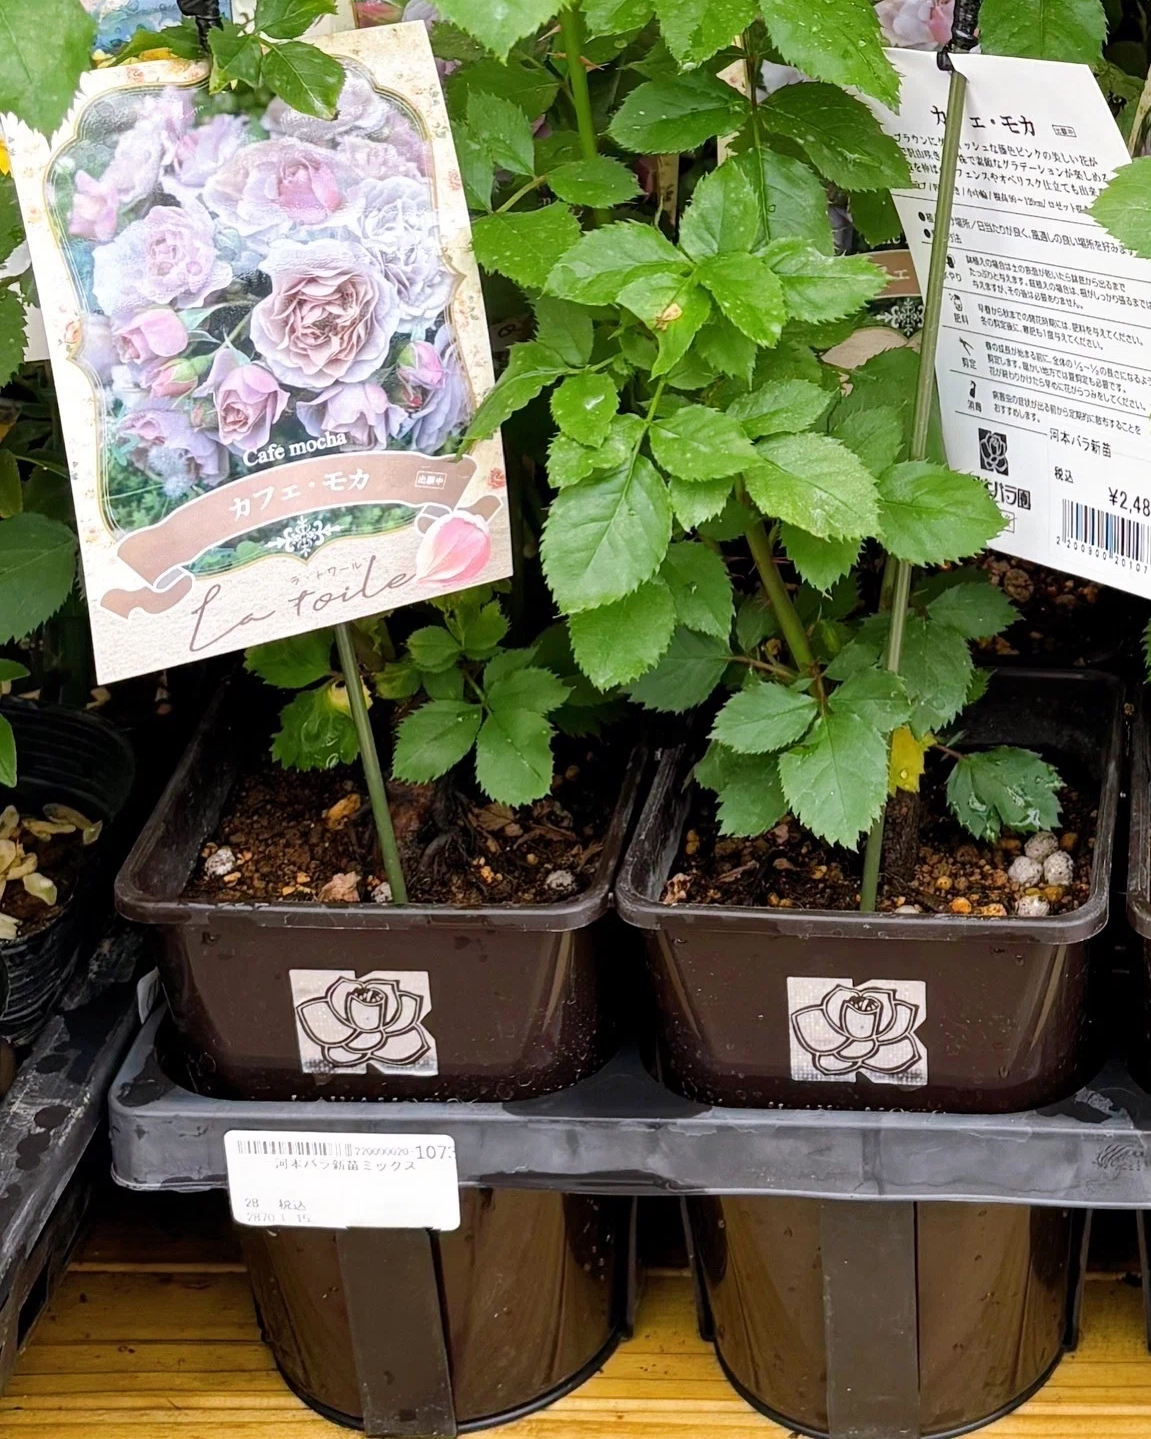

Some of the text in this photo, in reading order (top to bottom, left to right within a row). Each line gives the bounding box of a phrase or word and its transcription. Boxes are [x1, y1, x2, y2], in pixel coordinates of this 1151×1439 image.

[930, 105, 1036, 137] カェ・モカ
[243, 430, 347, 468] Café mocha
[1049, 428, 1112, 458] 河本バラ新苗
[1054, 466, 1074, 484] 税込
[227, 467, 371, 521] カフェ・モカ
[188, 555, 417, 653] La toile
